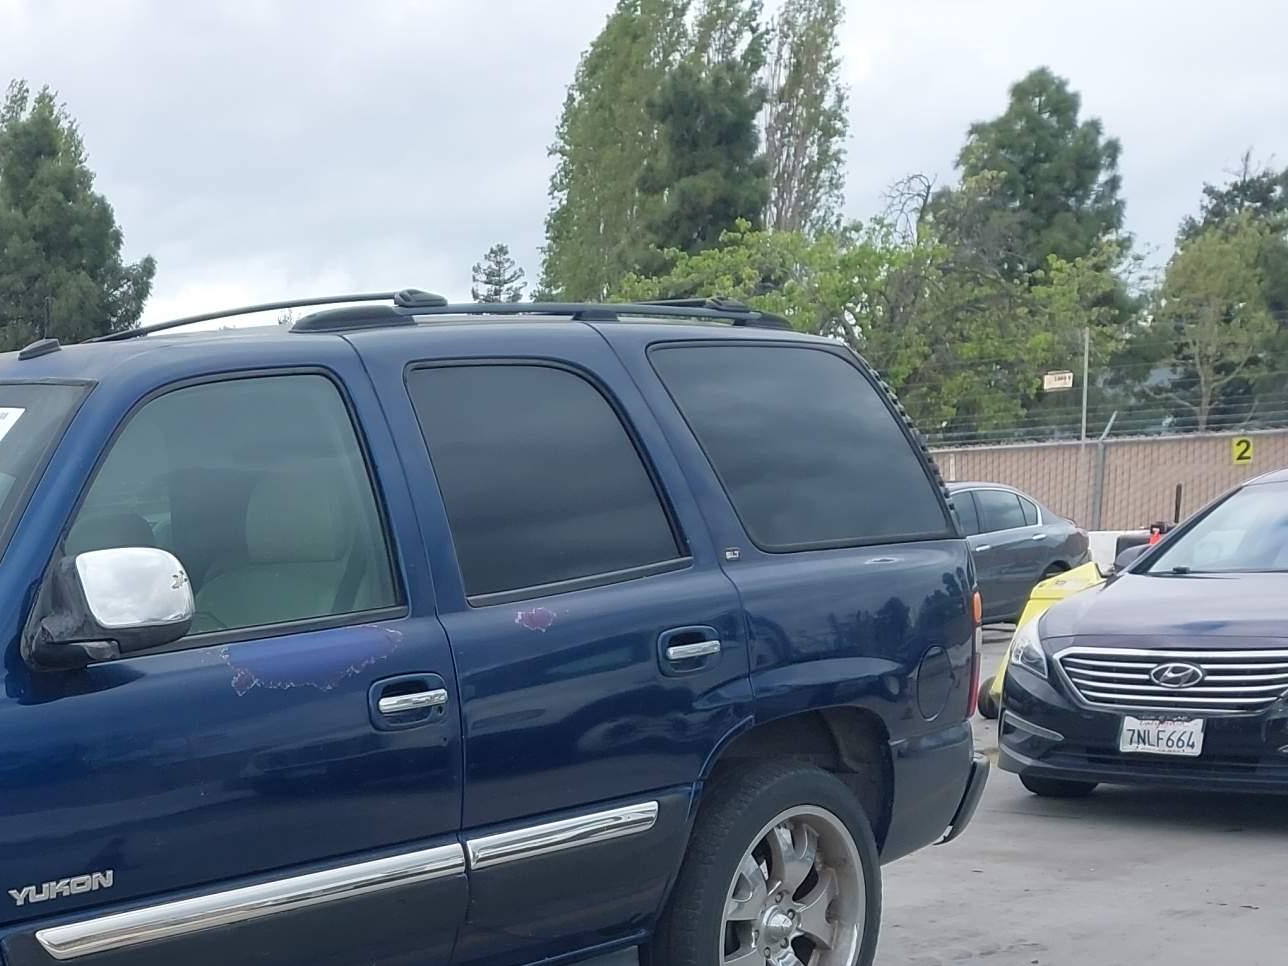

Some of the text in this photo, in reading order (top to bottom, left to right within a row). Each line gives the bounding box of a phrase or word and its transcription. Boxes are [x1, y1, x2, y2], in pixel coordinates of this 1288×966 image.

[1236, 439, 1252, 461] 2
[1126, 728, 1196, 750] 7NLF664
[8, 870, 114, 906] YUKON
